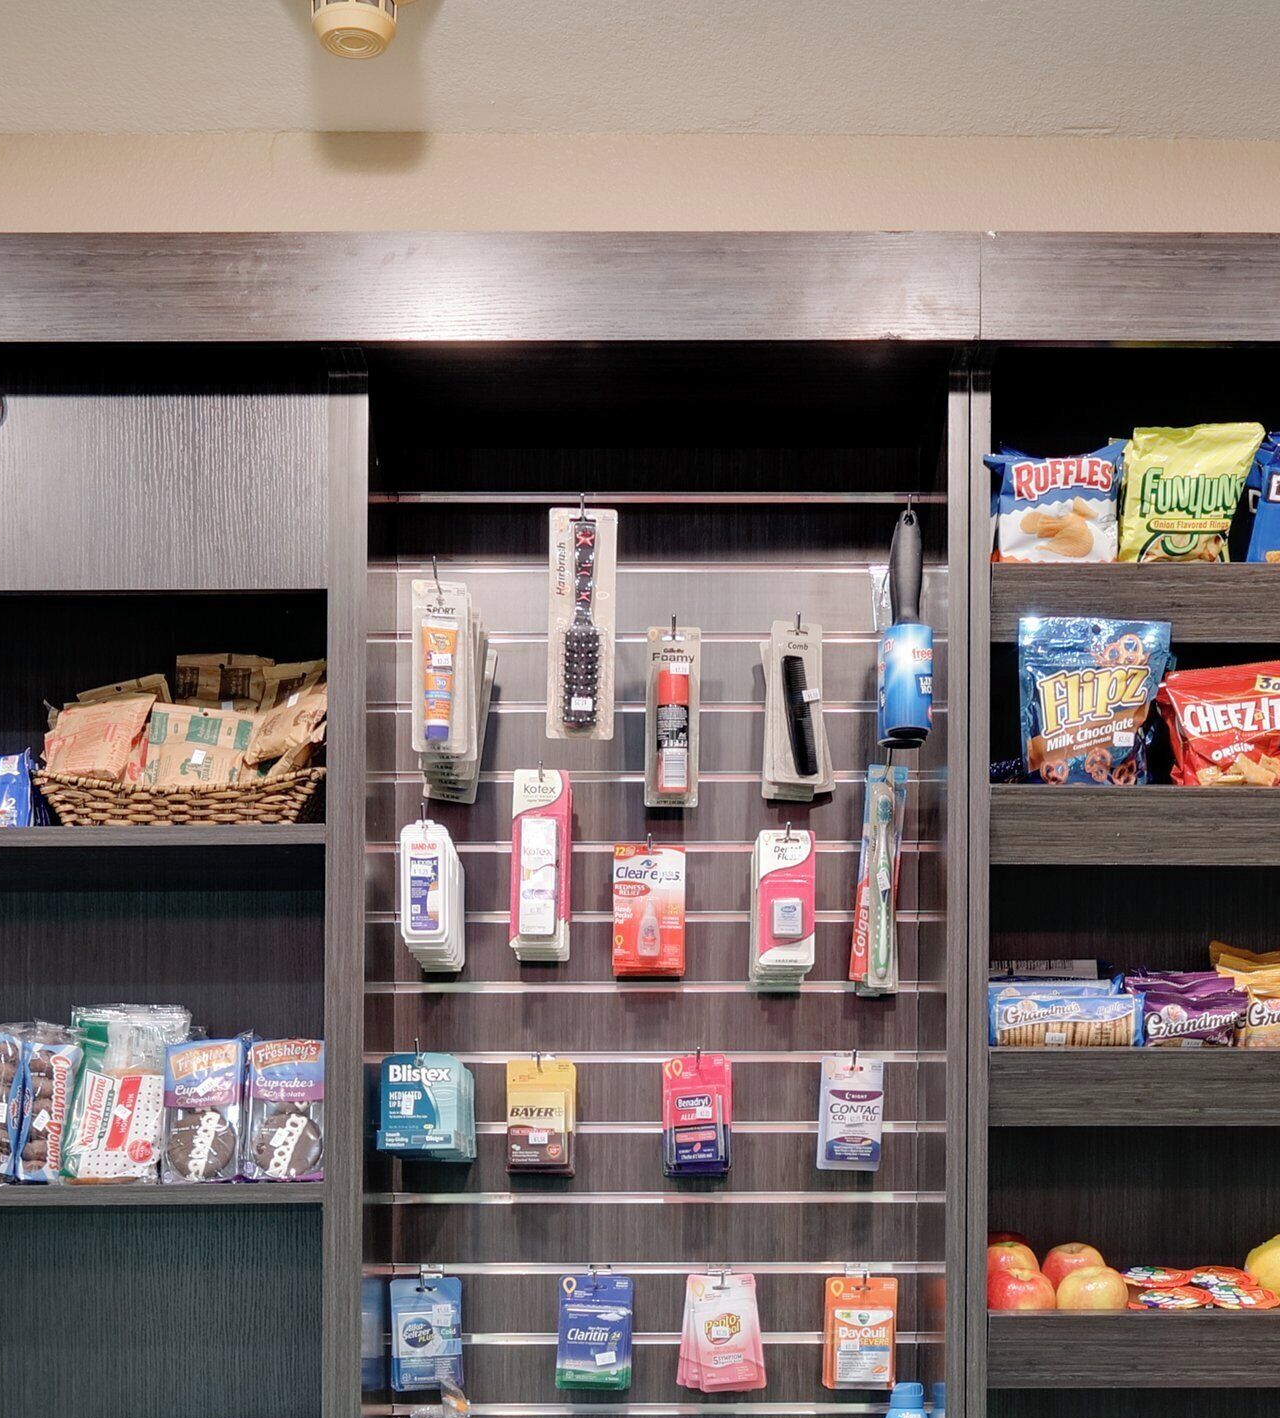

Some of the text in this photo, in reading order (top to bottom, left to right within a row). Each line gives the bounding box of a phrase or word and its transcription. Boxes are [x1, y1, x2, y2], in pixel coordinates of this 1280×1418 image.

[1013, 458, 1114, 500] RUFFLES
[1153, 520, 1229, 530] Onion Flavored Rings
[556, 542, 567, 597] Hairbrush
[787, 641, 809, 651] Comb
[651, 652, 695, 664] Foamy
[1039, 668, 1149, 735] Flipz
[1047, 718, 1134, 751] Milk Chocolate
[523, 783, 556, 795] Kotex
[411, 843, 438, 851] BAND-AID
[523, 847, 553, 856] Kotex
[615, 867, 649, 880] Clear
[1004, 1003, 1081, 1024] Grandma's
[388, 1065, 451, 1086] Blistex
[256, 1076, 315, 1090] Cupcakes
[267, 1090, 306, 1099] Chocolate
[677, 1097, 709, 1108] Benadryl
[510, 1107, 554, 1117] BAYER
[830, 1103, 879, 1115] CONTAC
[440, 1327, 456, 1336] Cold
[567, 1328, 608, 1342] Claritin
[839, 1327, 886, 1340] DayQuil
